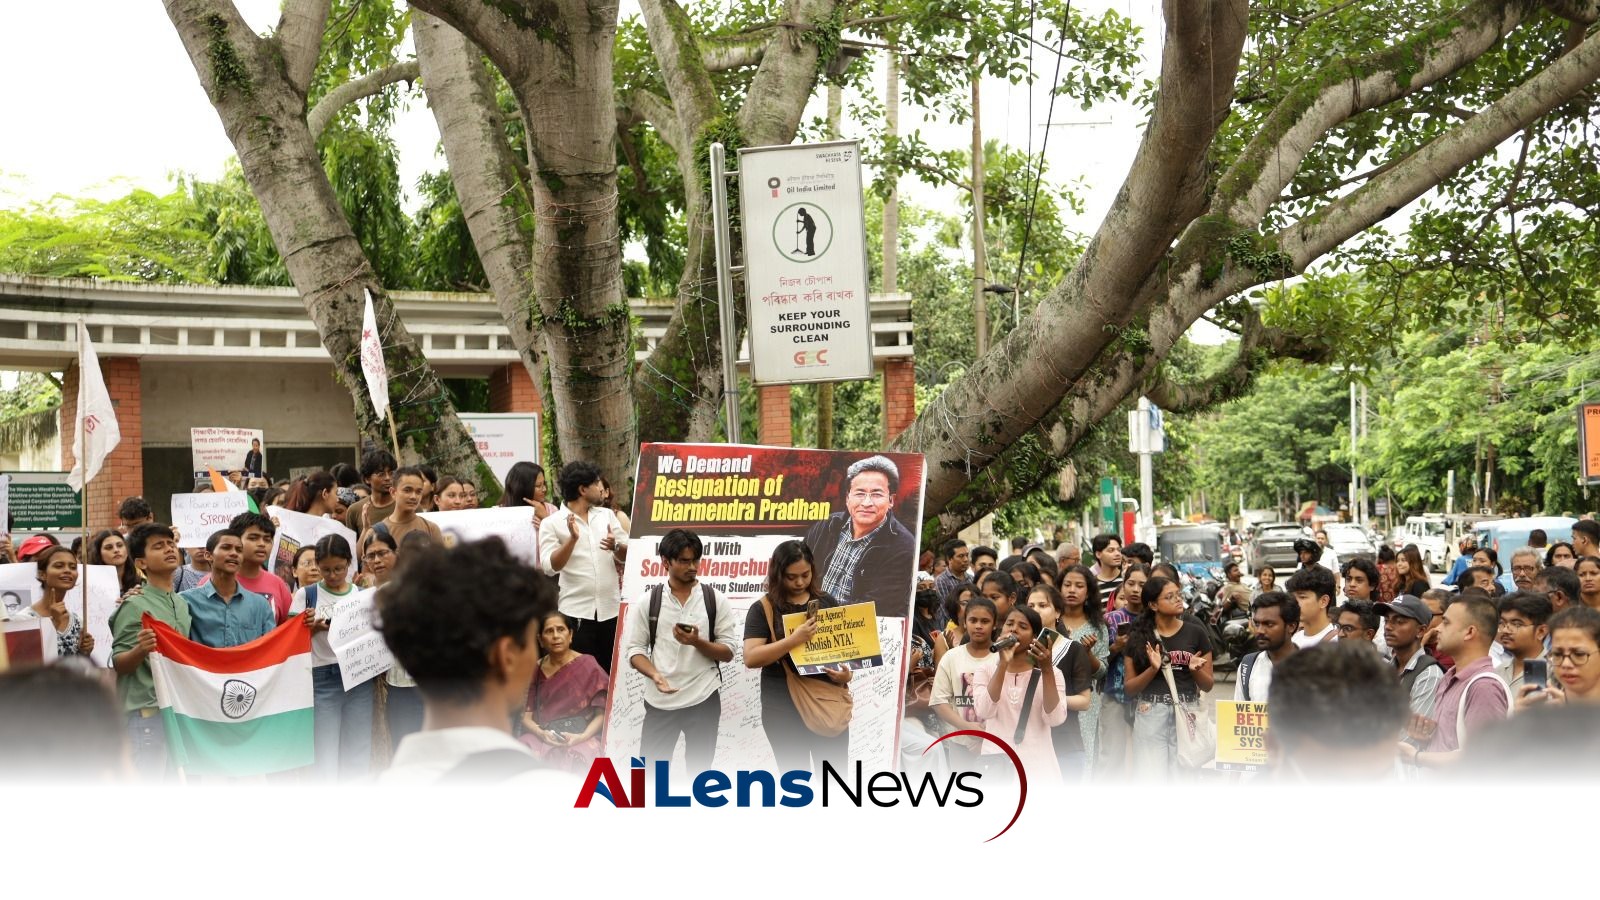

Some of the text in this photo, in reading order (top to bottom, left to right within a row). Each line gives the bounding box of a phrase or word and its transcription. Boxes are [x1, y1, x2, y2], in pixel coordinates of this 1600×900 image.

[786, 186, 795, 194] Oil
[796, 185, 812, 193] India
[779, 309, 841, 321] KEEP YOUR
[770, 320, 851, 333] SURROUNDING
[792, 333, 829, 343] CLEAN
[657, 454, 753, 474] We Demand
[653, 474, 784, 500] Resignation of
[650, 498, 831, 522] Dharmendra Pradhan
[713, 542, 742, 556] With
[640, 557, 772, 579] Son Wangchu
[728, 582, 769, 593] Students
[824, 607, 847, 621] Agency?
[842, 617, 866, 630] Patience!
[805, 632, 855, 652] Abolish NTA!
[1235, 703, 1269, 713] WE WA
[1233, 726, 1264, 737] EDUC
[1239, 737, 1263, 748] SYS
